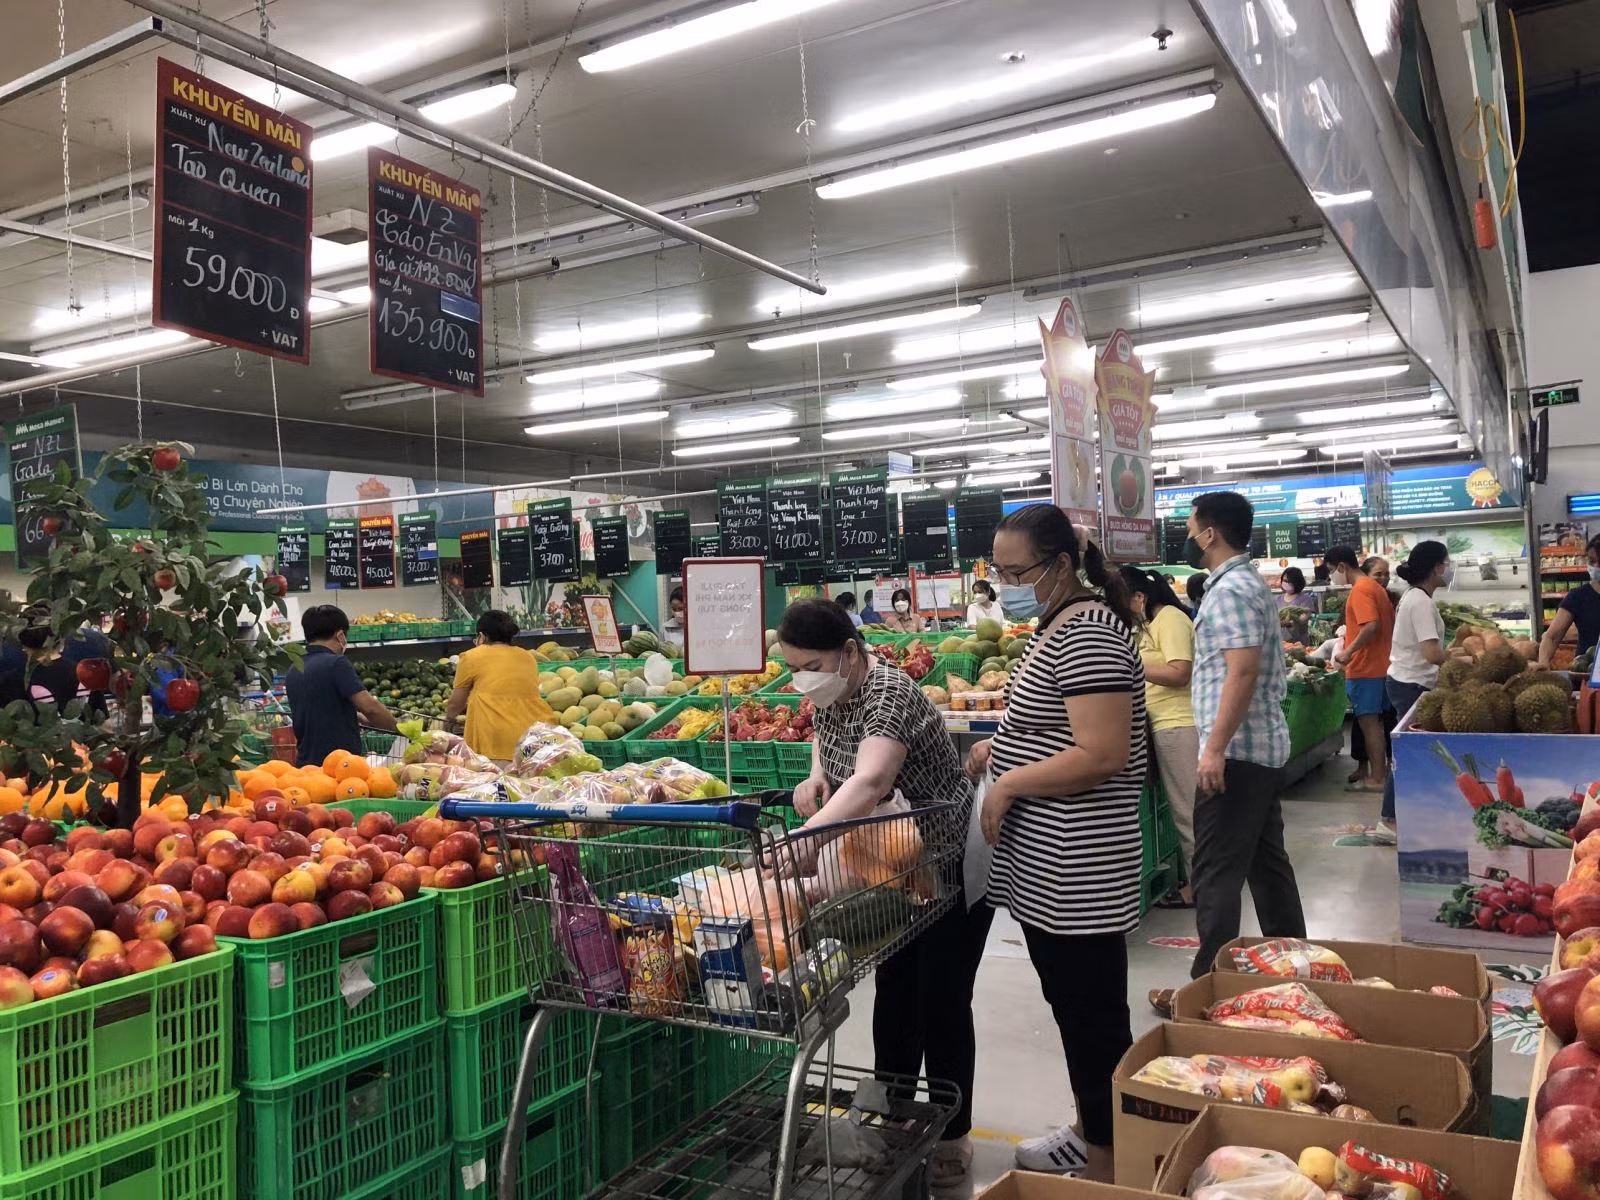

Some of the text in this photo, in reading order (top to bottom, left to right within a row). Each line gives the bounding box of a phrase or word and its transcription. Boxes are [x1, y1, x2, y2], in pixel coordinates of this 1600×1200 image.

[171, 106, 193, 120] XUẤT
[173, 77, 301, 149] KHUYẾN MÃI
[208, 121, 249, 161] New
[219, 167, 281, 208] Queen
[380, 160, 472, 211] KHUYẾN MÃI
[188, 218, 200, 232] 1
[201, 225, 215, 239] Kg
[375, 248, 397, 272] Giá
[183, 246, 300, 319] 59.000 Đ
[392, 274, 402, 292] 1
[402, 284, 412, 295] Kg
[379, 297, 469, 356] 135.900
[272, 330, 298, 348] VAT
[456, 369, 476, 383] VAT
[1113, 403, 1138, 421] GIÁ TỐT
[212, 478, 303, 496] Bì Lớn Dành Cho
[866, 485, 884, 494] Nam
[223, 495, 266, 510] Chuyên
[772, 500, 793, 511] Thanh
[836, 498, 861, 509] Thanh
[218, 511, 251, 519] Professional
[722, 507, 744, 516] Thanh
[776, 532, 812, 549] 41.000
[841, 530, 877, 546] 37.000
[366, 566, 390, 578] 45.000
[407, 561, 430, 574] 37.000
